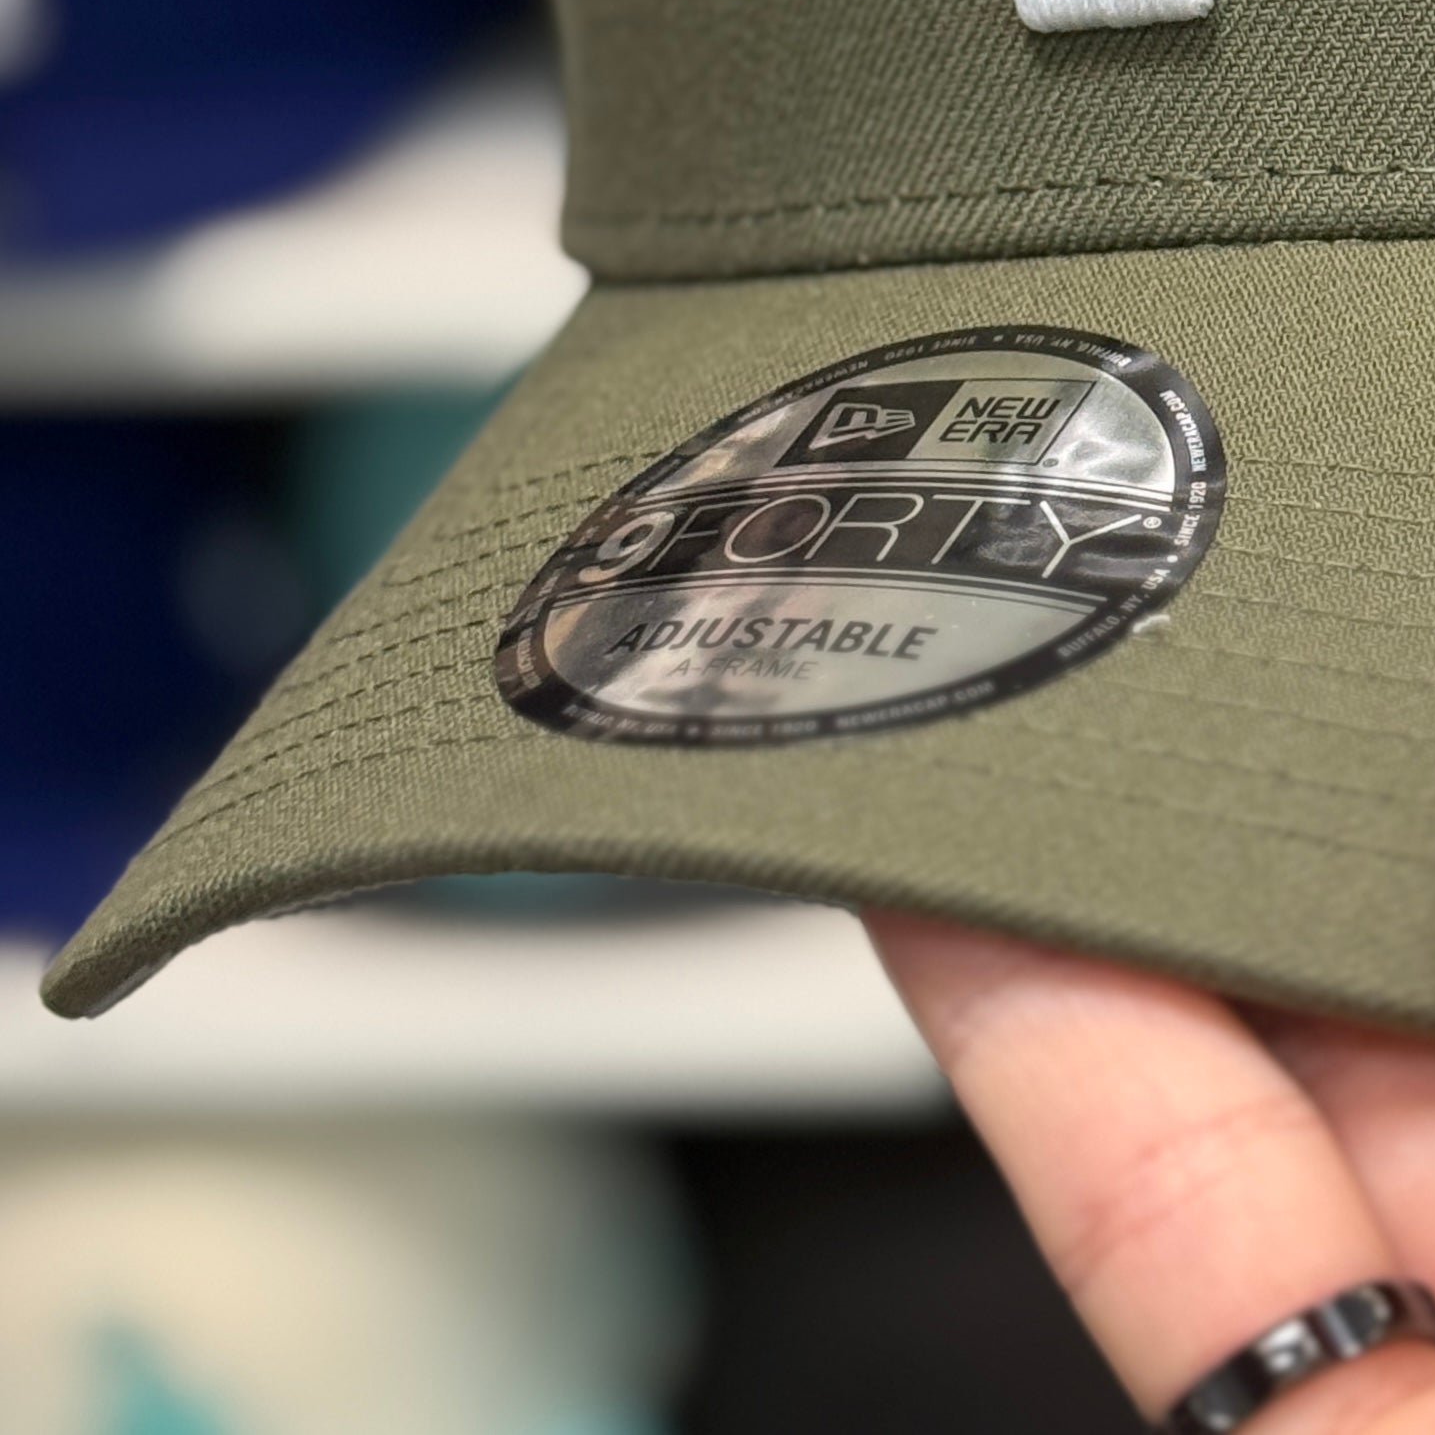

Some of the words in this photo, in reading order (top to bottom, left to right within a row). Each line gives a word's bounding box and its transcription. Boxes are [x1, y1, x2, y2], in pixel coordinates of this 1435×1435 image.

[955, 396, 1061, 420] NEW
[938, 419, 1043, 445] ERA
[1159, 388, 1208, 473] NEWERACAP.COM
[1187, 480, 1208, 516] 1920
[1174, 513, 1201, 548] SINCE
[1141, 567, 1171, 592] USA
[603, 616, 939, 661] ADJUSTABLE
[665, 657, 820, 680] A-FRAME
[711, 723, 763, 738] SINCE
[770, 720, 818, 735] 1920
